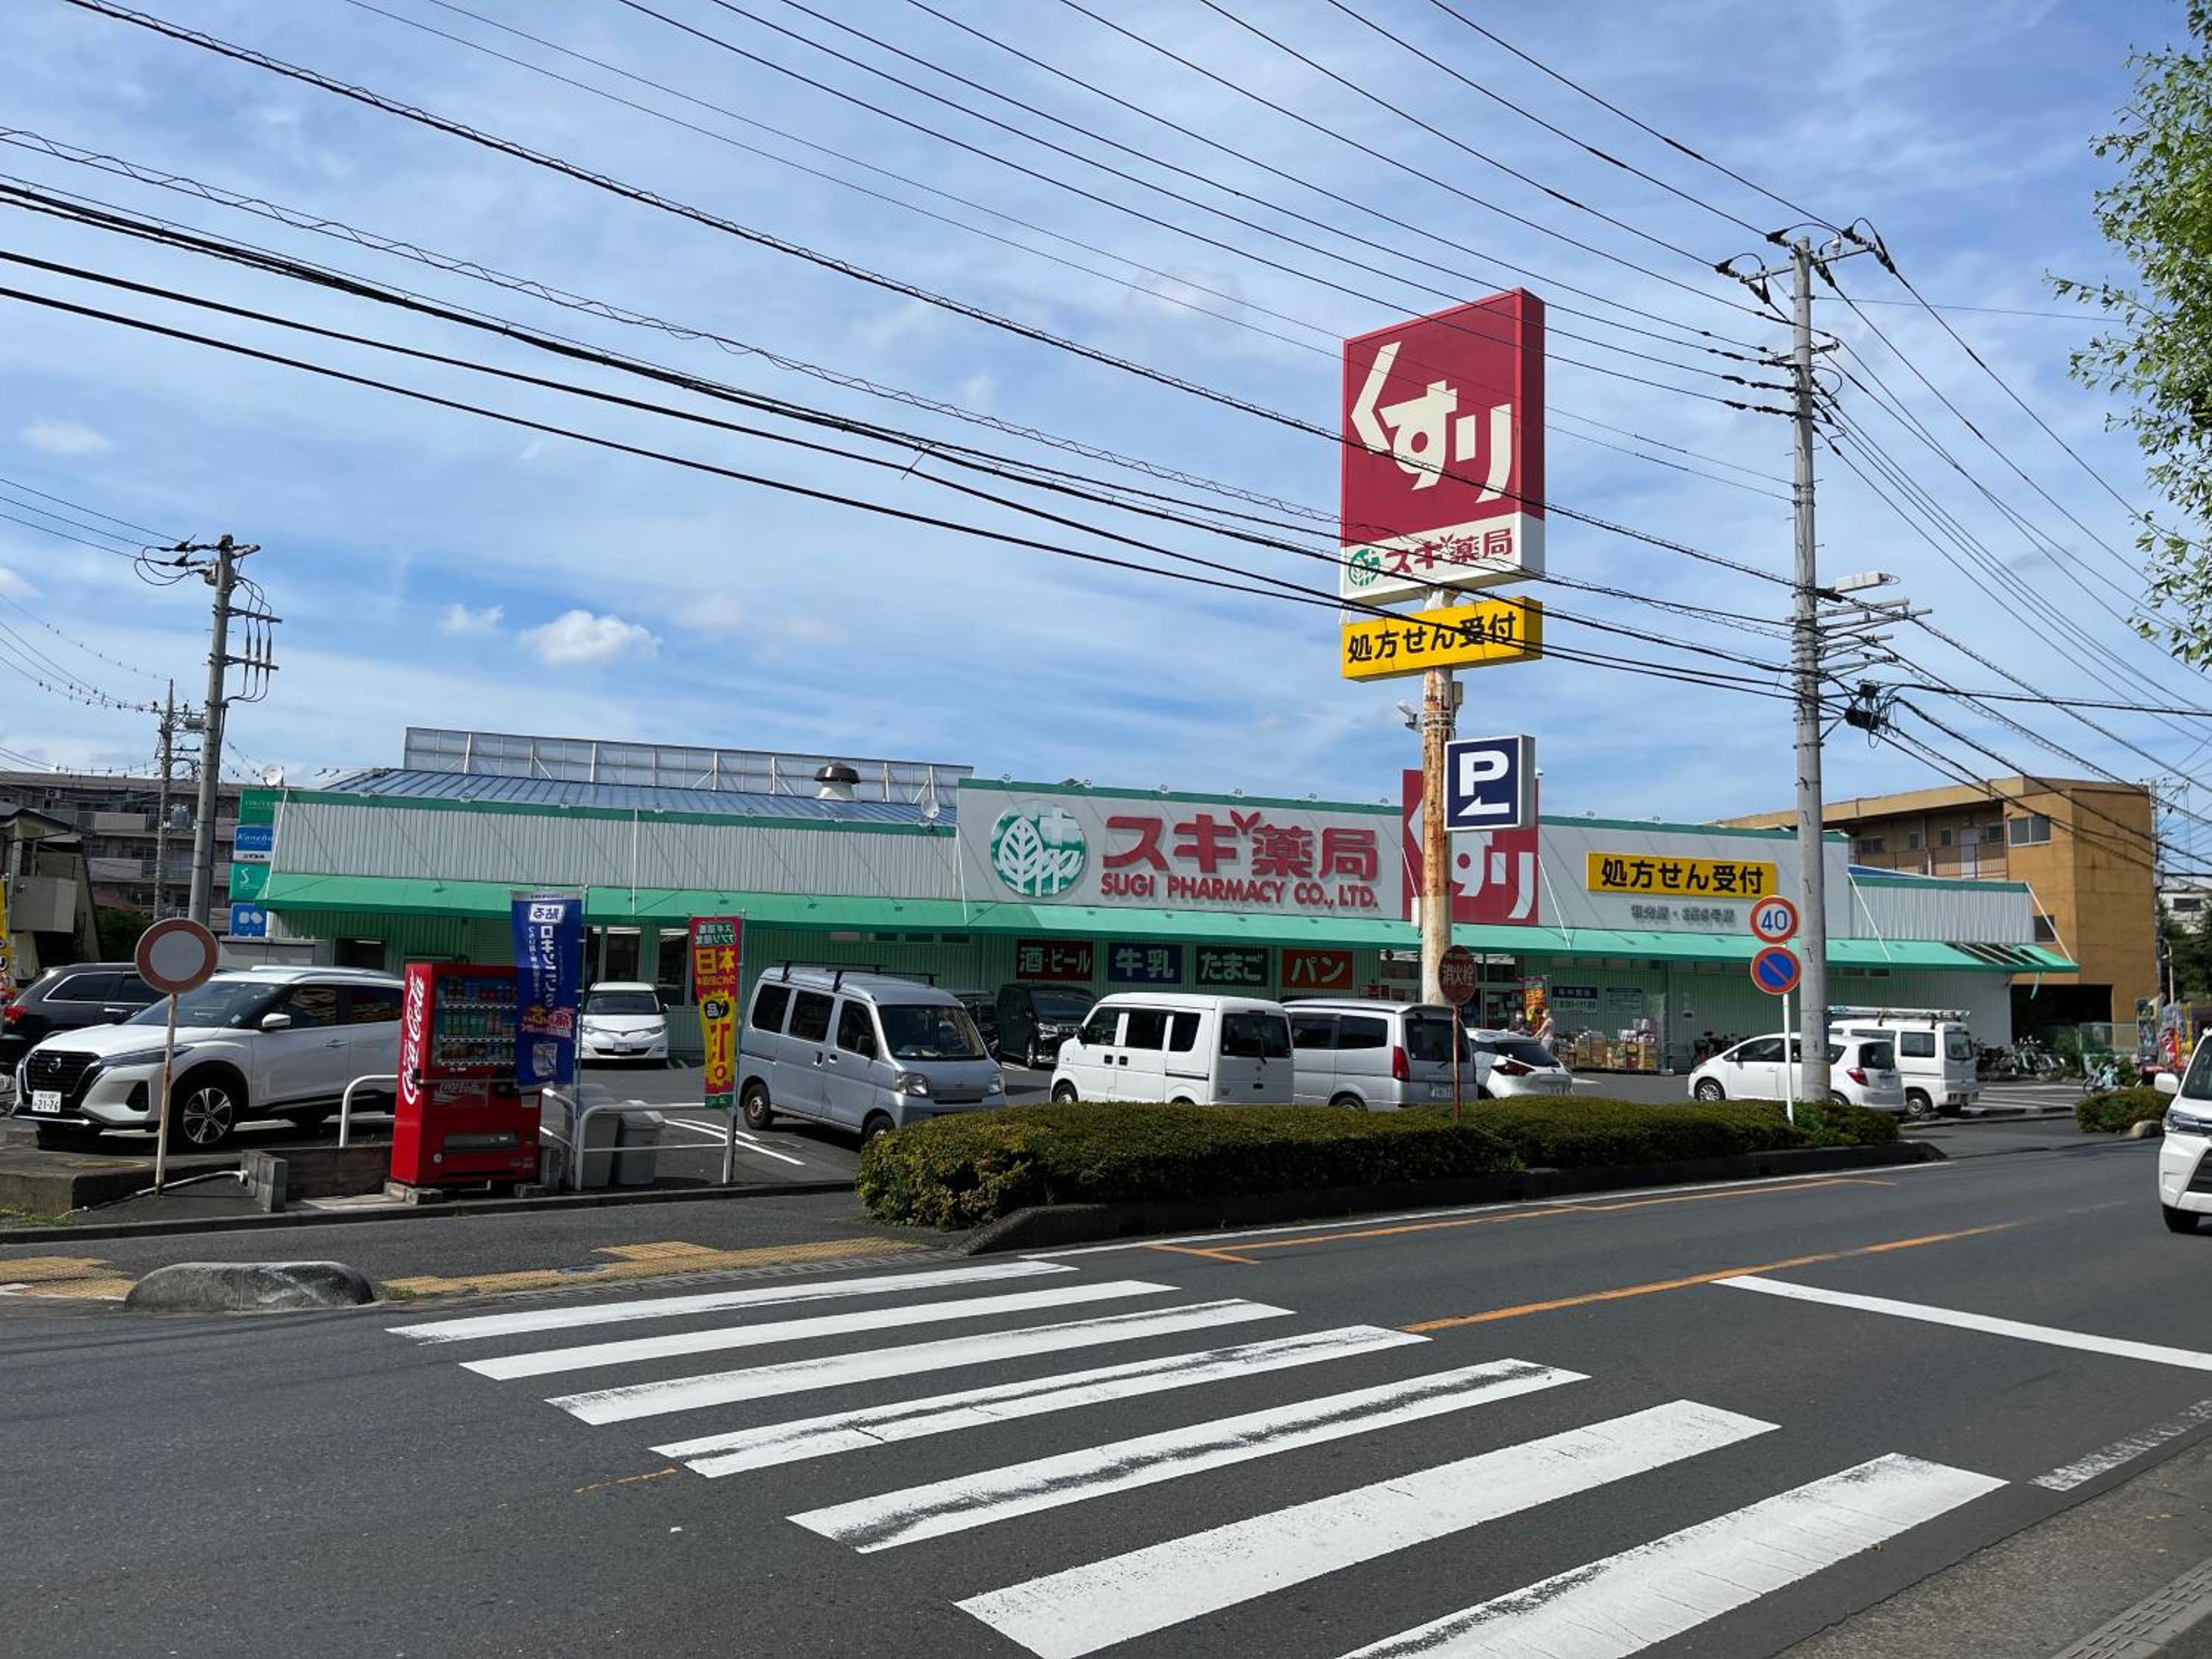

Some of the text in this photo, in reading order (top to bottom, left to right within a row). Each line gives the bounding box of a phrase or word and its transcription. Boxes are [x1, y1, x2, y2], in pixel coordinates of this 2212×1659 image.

[1351, 341, 1512, 504] くすり
[1384, 527, 1512, 576] スギ薬局
[1347, 611, 1517, 664] 処方せん受付
[1459, 750, 1509, 797] P
[1103, 810, 1379, 882] スギ薬局
[1101, 872, 1379, 909] SUGI PHARMACY CO., LTD.
[1601, 858, 1764, 894] 処方せん受付
[1761, 909, 1788, 931] 40
[1018, 946, 1091, 973] 酒・ビール
[1116, 948, 1175, 979] 牛乳
[1200, 952, 1263, 981] たまご
[1290, 956, 1346, 984] パン
[1442, 963, 1475, 986] 消火栓
